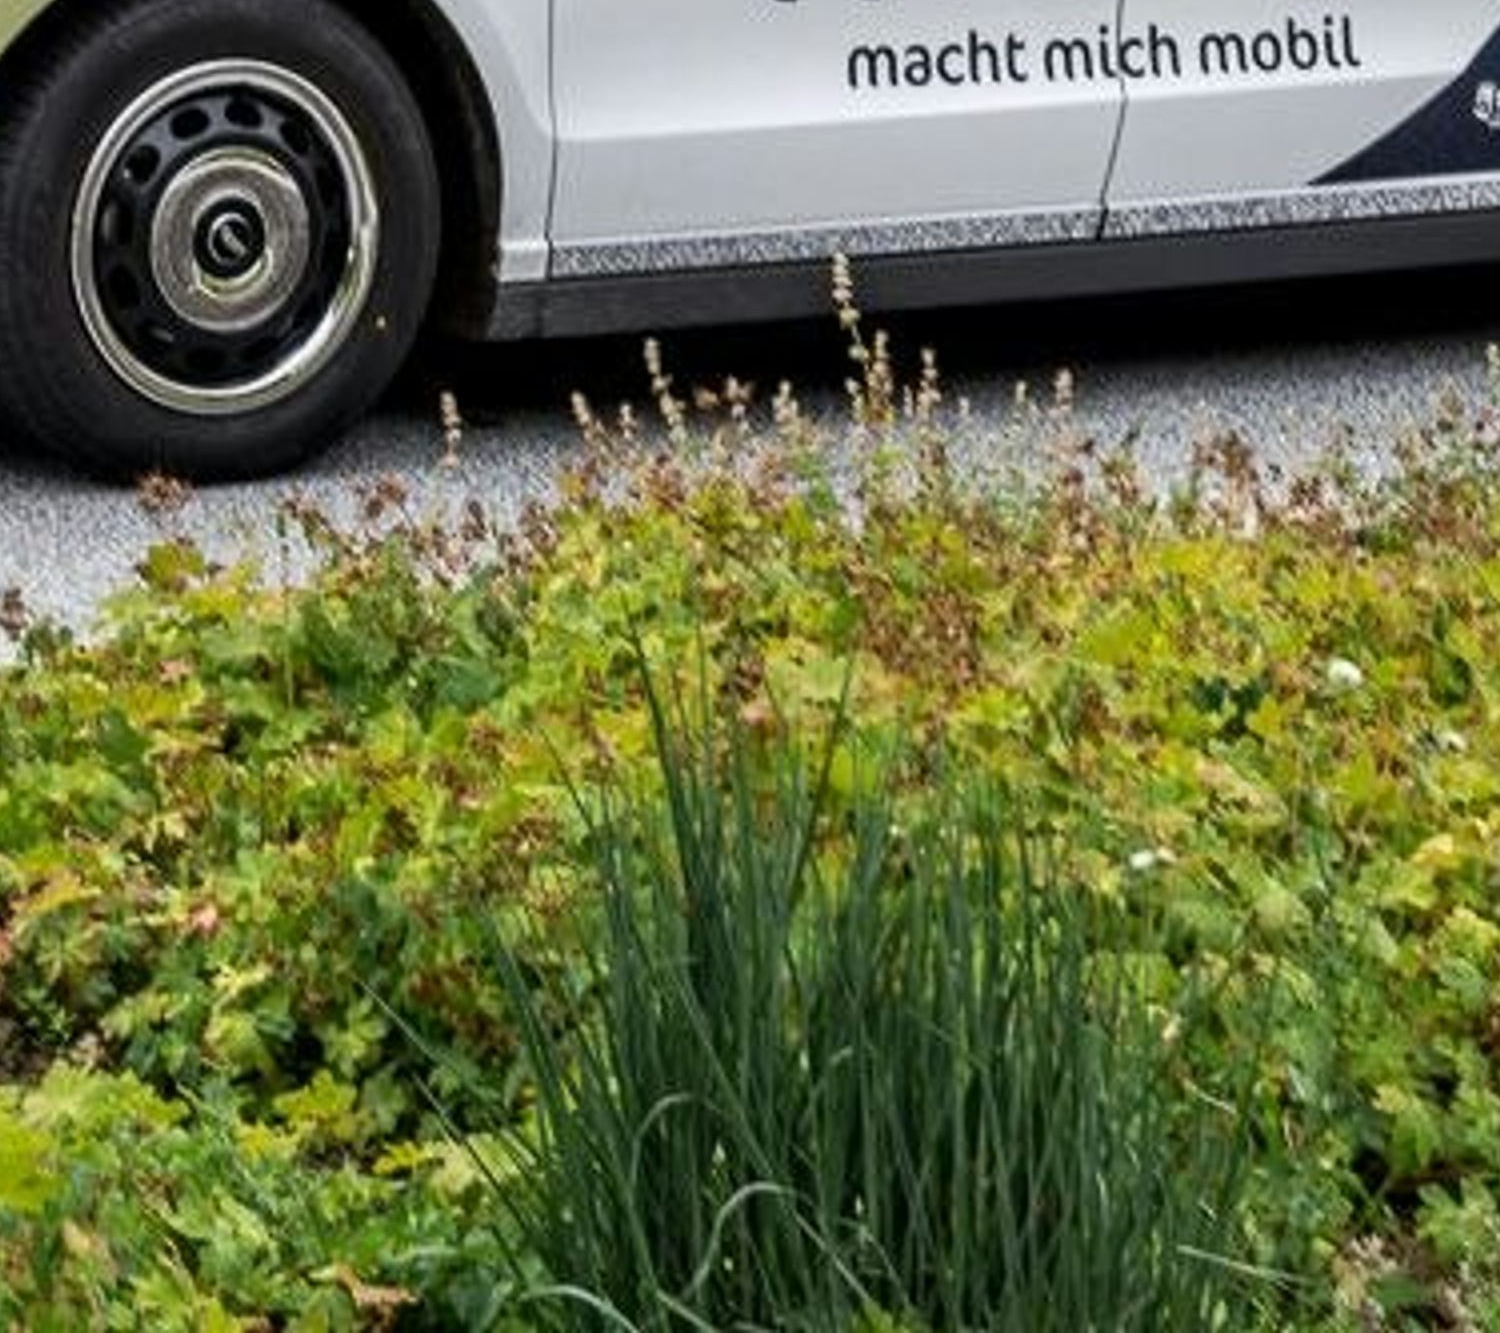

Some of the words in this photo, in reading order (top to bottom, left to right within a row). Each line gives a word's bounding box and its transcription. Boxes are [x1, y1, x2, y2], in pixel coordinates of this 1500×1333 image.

[847, 30, 1028, 90] macht
[1043, 24, 1181, 81] mich
[1199, 14, 1360, 75] mobil
